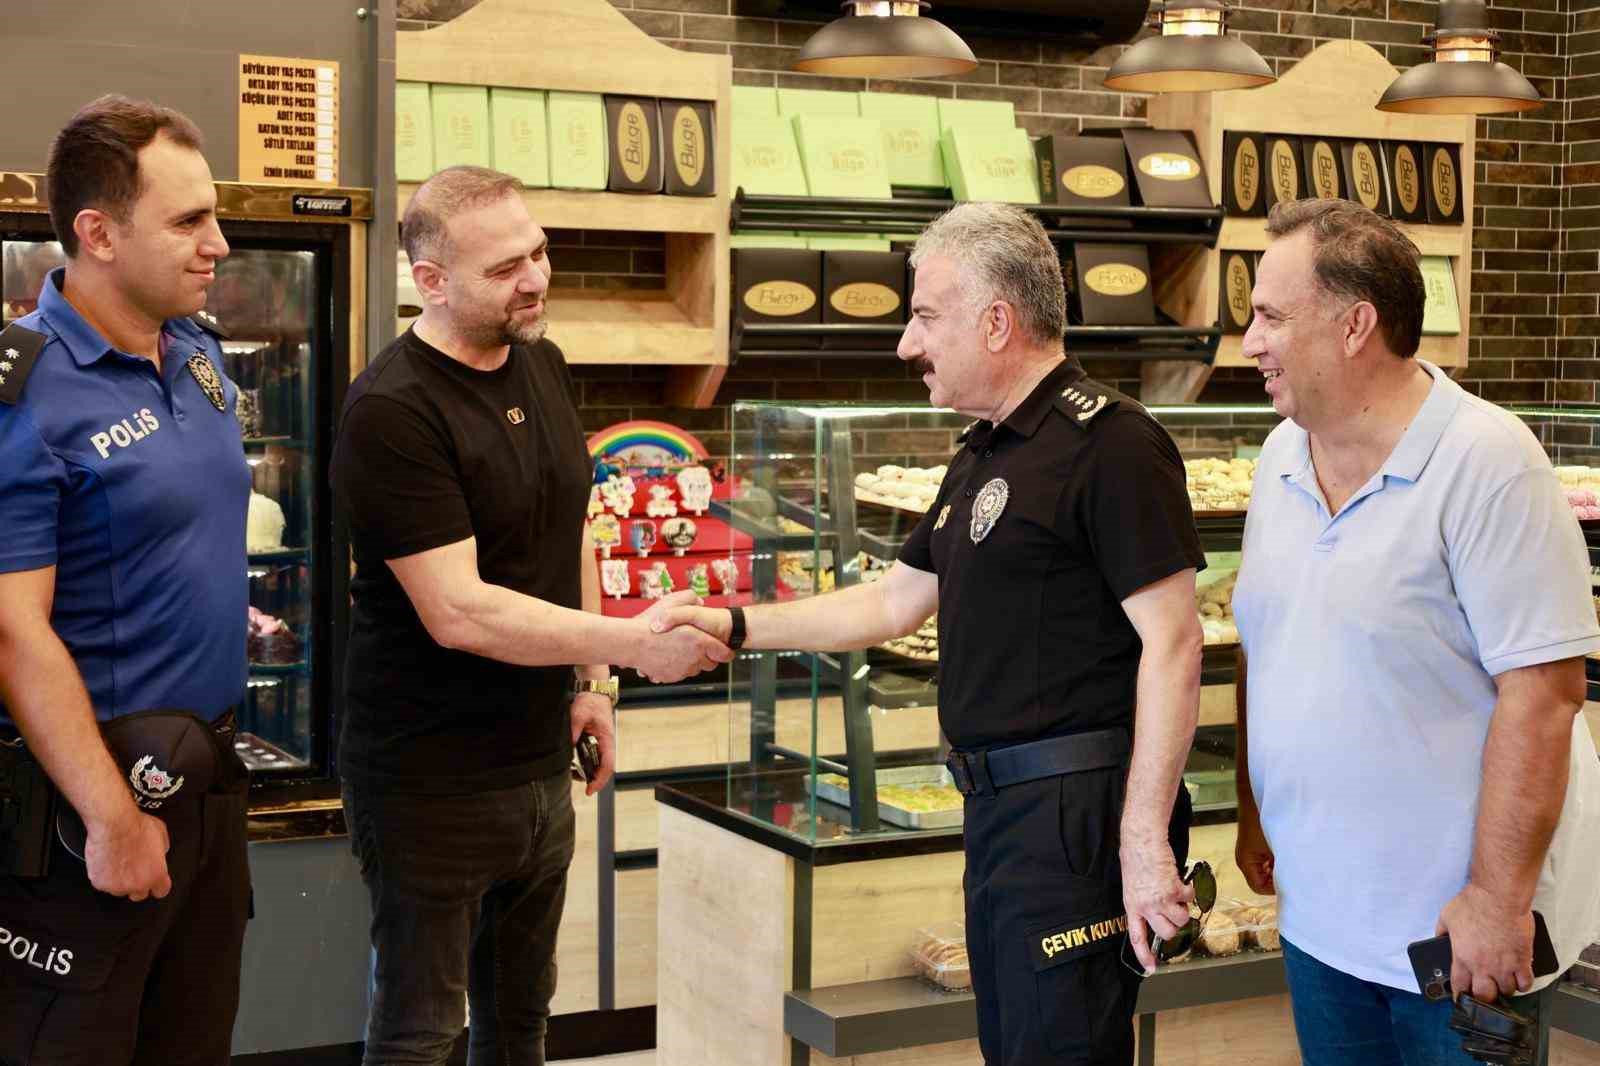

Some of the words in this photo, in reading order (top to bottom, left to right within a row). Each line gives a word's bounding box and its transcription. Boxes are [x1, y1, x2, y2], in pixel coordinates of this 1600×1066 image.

[242, 62, 265, 74] BÜYÜK
[266, 65, 280, 76] BOY
[294, 67, 316, 79] PASTA
[248, 78, 265, 89] ORTA
[266, 80, 280, 90] BOY
[294, 82, 316, 93] PASTA
[266, 93, 280, 105] BOY
[294, 96, 316, 108] PASTA
[276, 110, 293, 121] ADET
[294, 111, 316, 122] PASTA
[294, 125, 316, 137] PASTA
[1041, 926, 1090, 958] ÇEVİK
